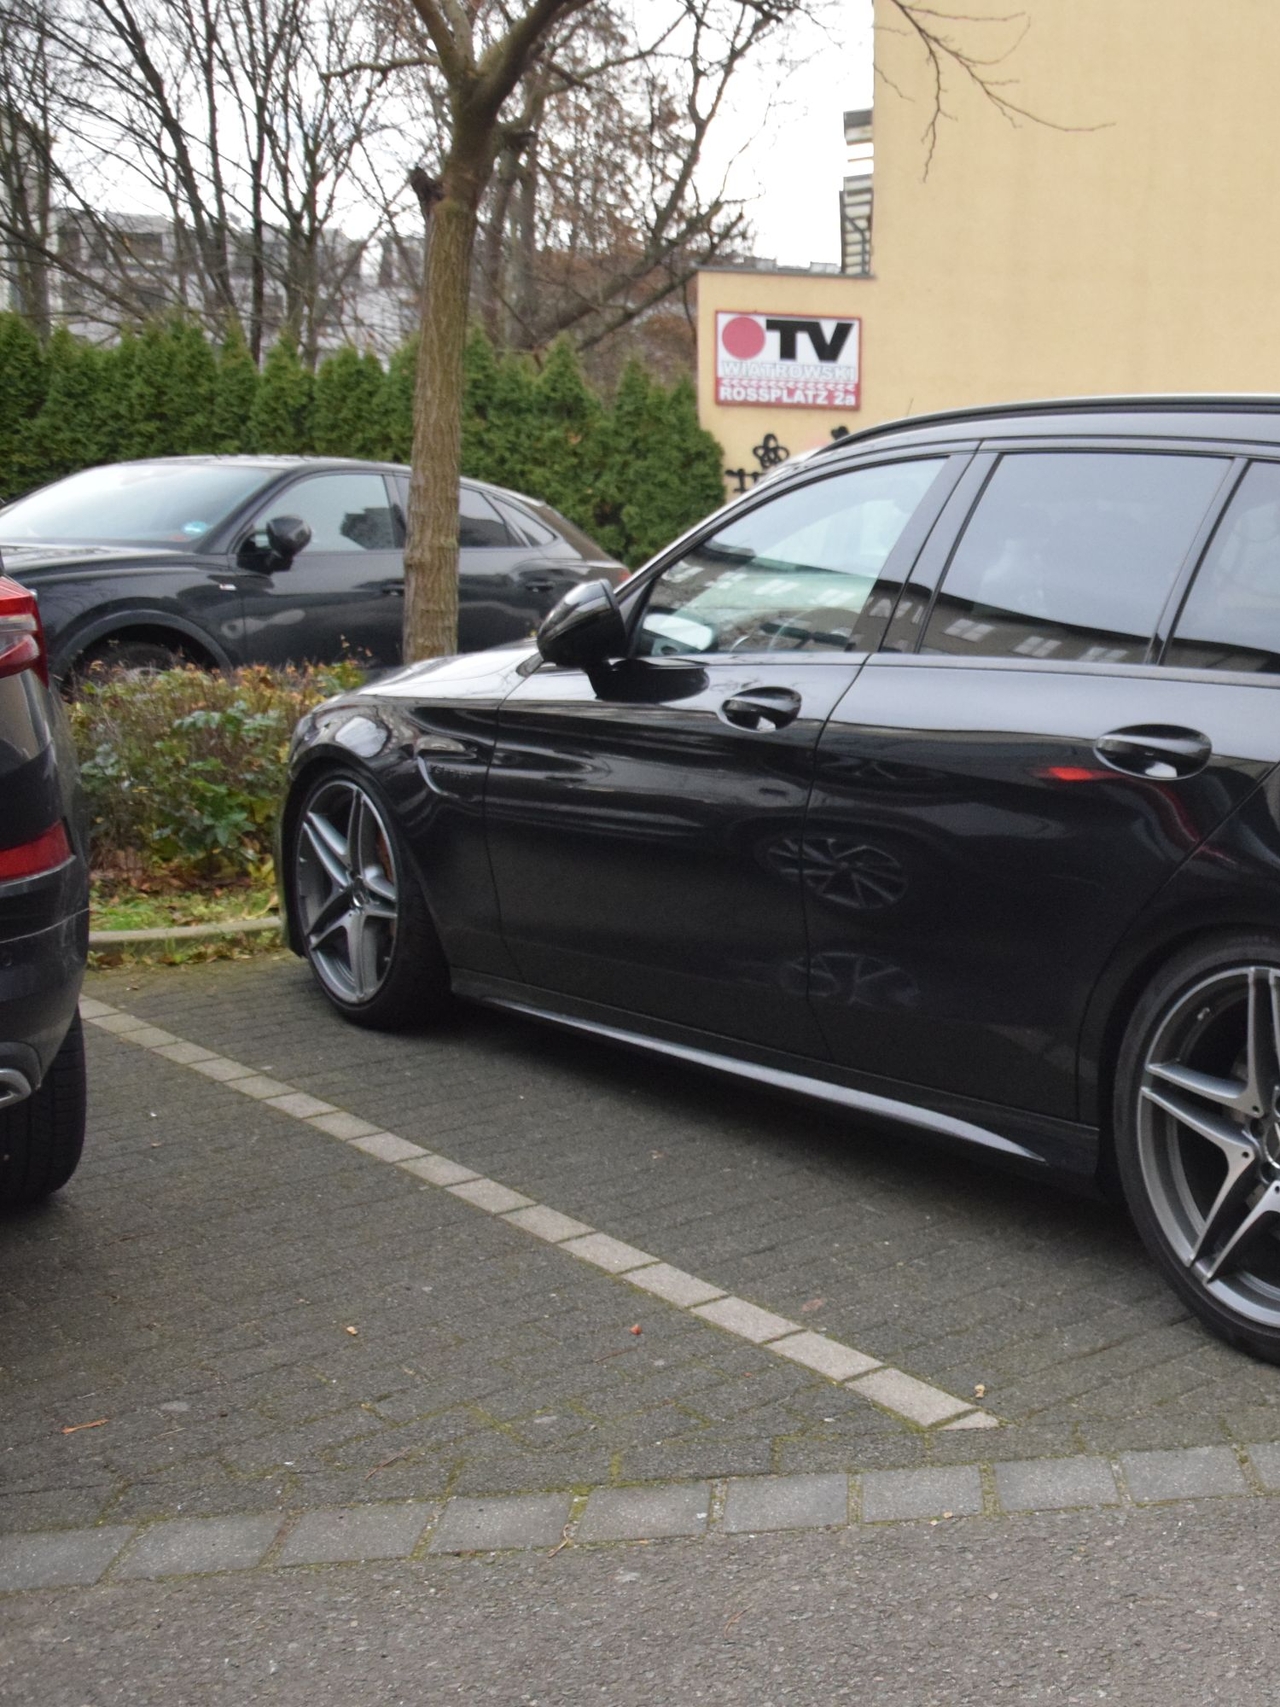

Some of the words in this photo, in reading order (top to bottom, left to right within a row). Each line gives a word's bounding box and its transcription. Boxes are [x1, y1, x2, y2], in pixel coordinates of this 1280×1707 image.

[722, 360, 856, 382] WIATROWSKI
[719, 386, 828, 405] ROSSPLATZ
[833, 391, 856, 406] 2a
